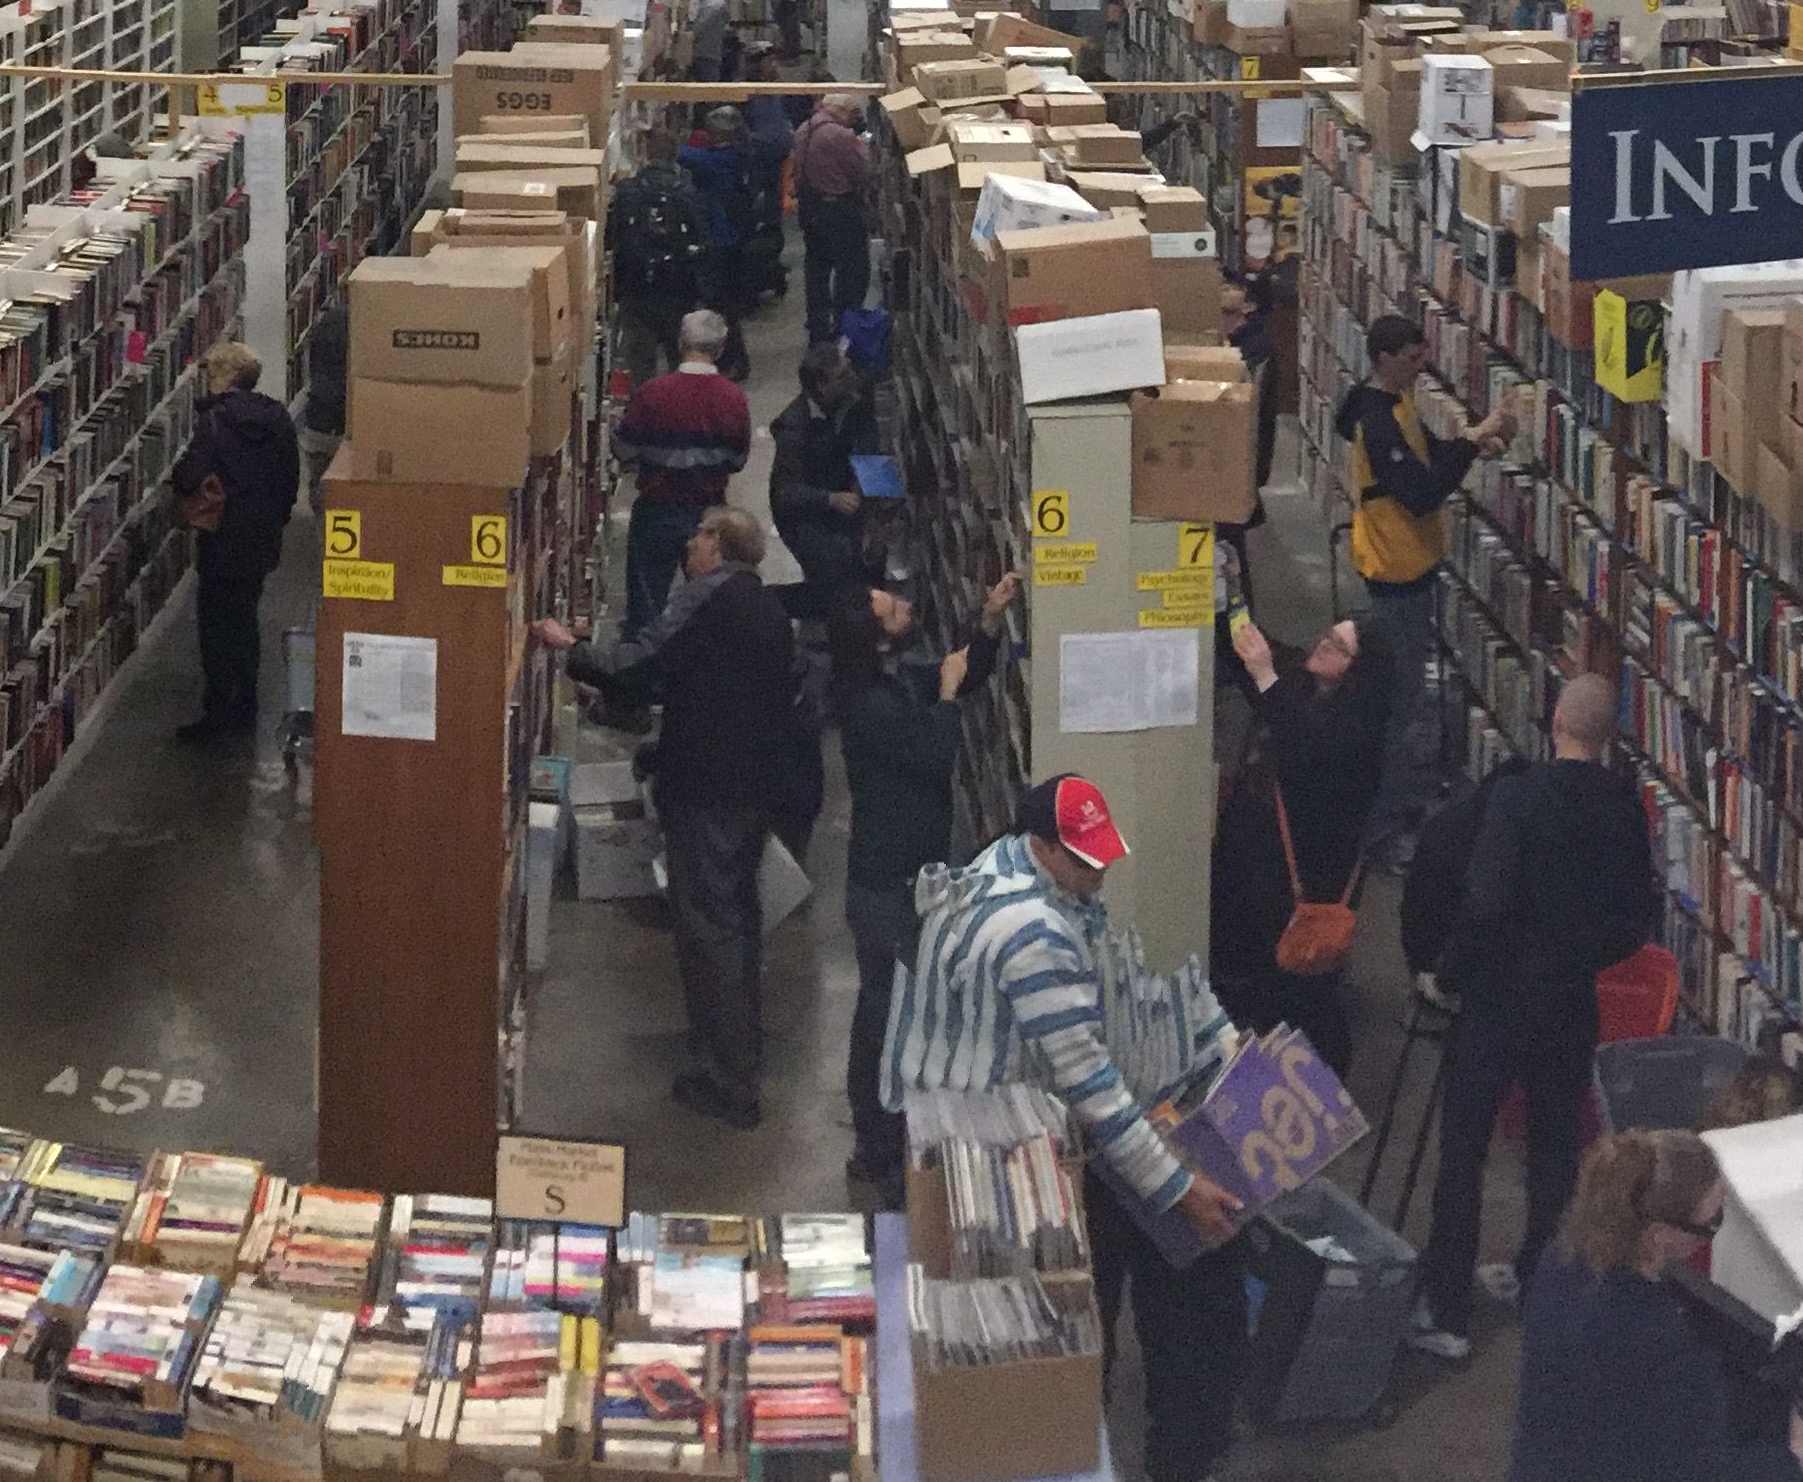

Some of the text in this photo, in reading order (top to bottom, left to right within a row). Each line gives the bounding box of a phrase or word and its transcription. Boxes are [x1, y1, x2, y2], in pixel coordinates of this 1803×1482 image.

[1245, 58, 1257, 76] 7
[203, 84, 283, 103] 4 5
[496, 90, 552, 111] EGGS
[1037, 495, 1065, 532] 6
[330, 516, 501, 559] 5 6
[1185, 527, 1210, 563] 7
[1044, 546, 1095, 562] Religion
[1039, 568, 1083, 584] Vintage
[544, 1184, 566, 1216] S
